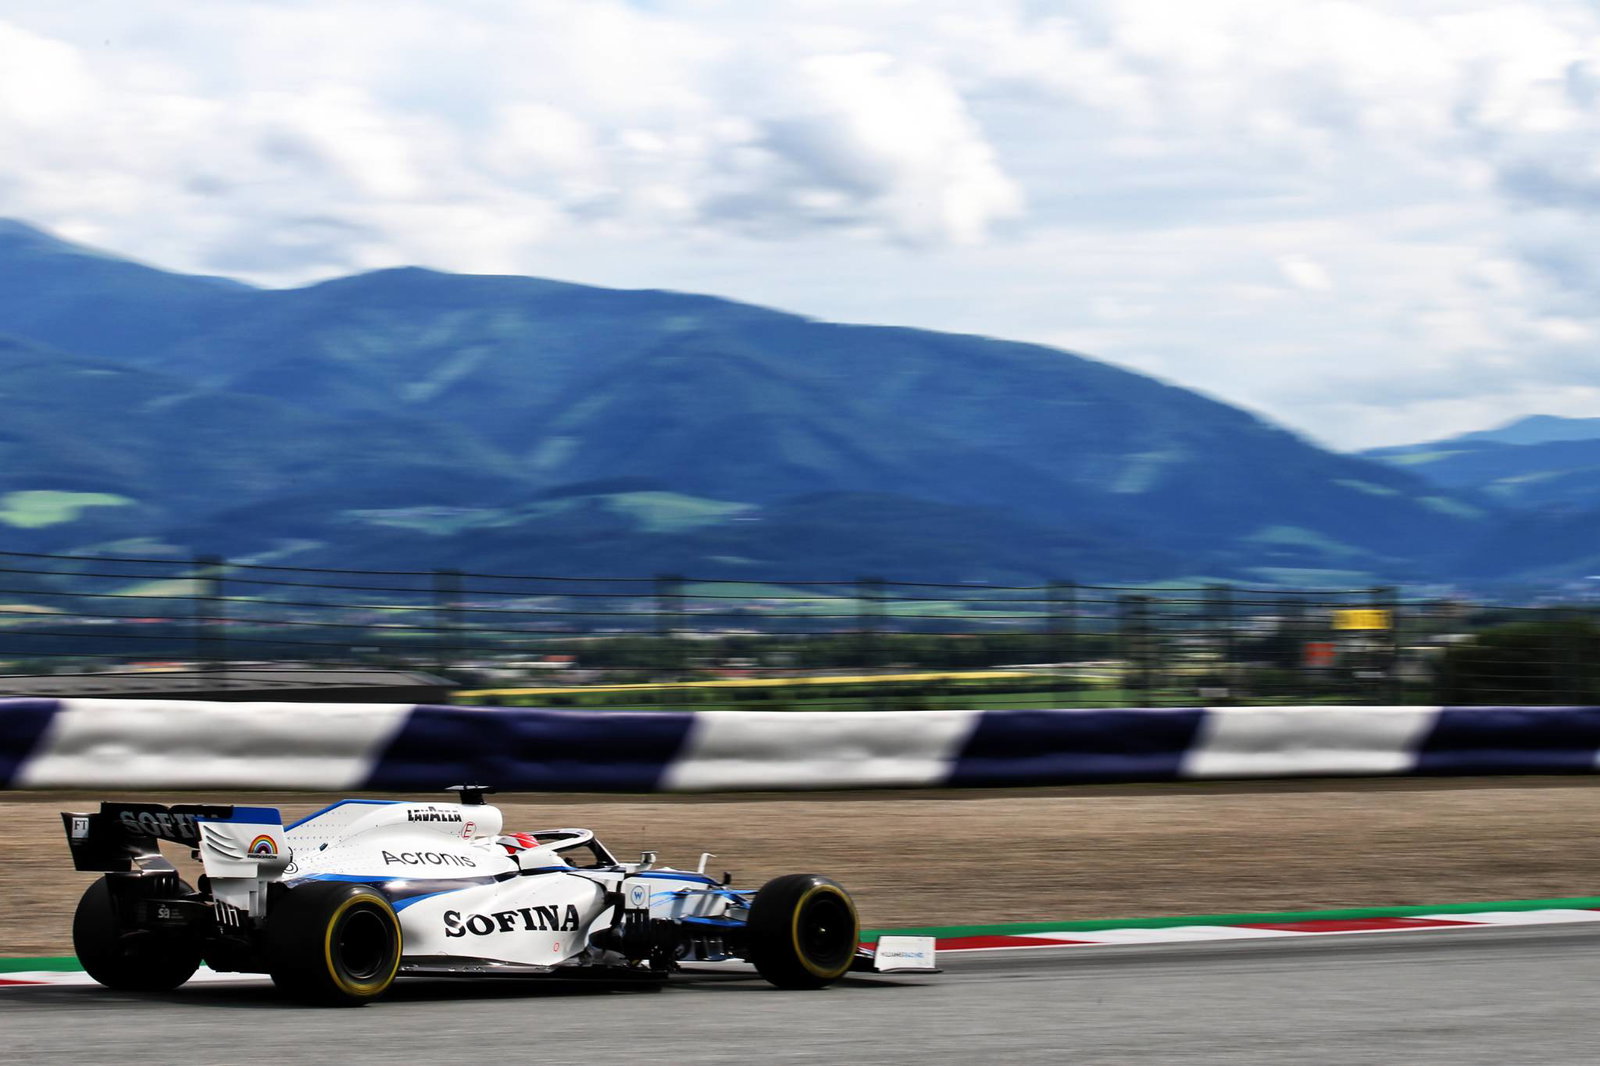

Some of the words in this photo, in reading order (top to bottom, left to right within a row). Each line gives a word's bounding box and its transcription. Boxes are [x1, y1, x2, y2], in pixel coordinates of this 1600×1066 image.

[74, 820, 87, 830] FT
[120, 811, 218, 838] SOFI
[381, 850, 476, 867] Acronis
[634, 891, 643, 900] W
[443, 904, 580, 937] SOFINA
